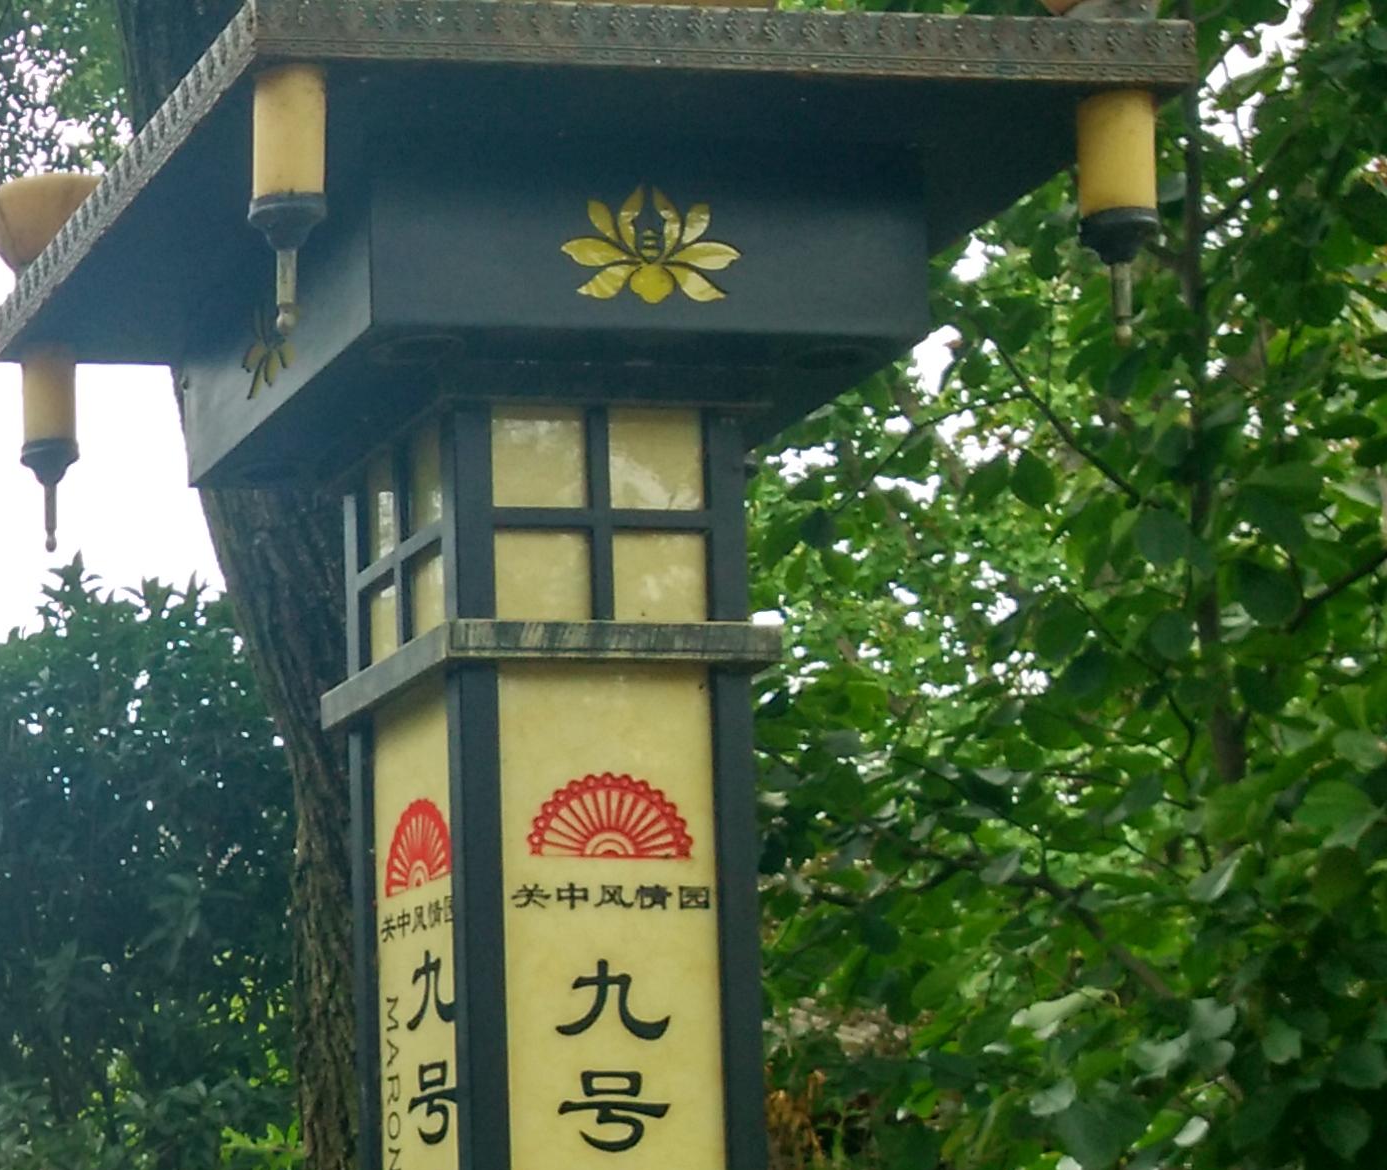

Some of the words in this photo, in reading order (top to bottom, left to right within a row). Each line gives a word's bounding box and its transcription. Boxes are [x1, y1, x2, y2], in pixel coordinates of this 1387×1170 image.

[511, 882, 711, 911] 关中风情园
